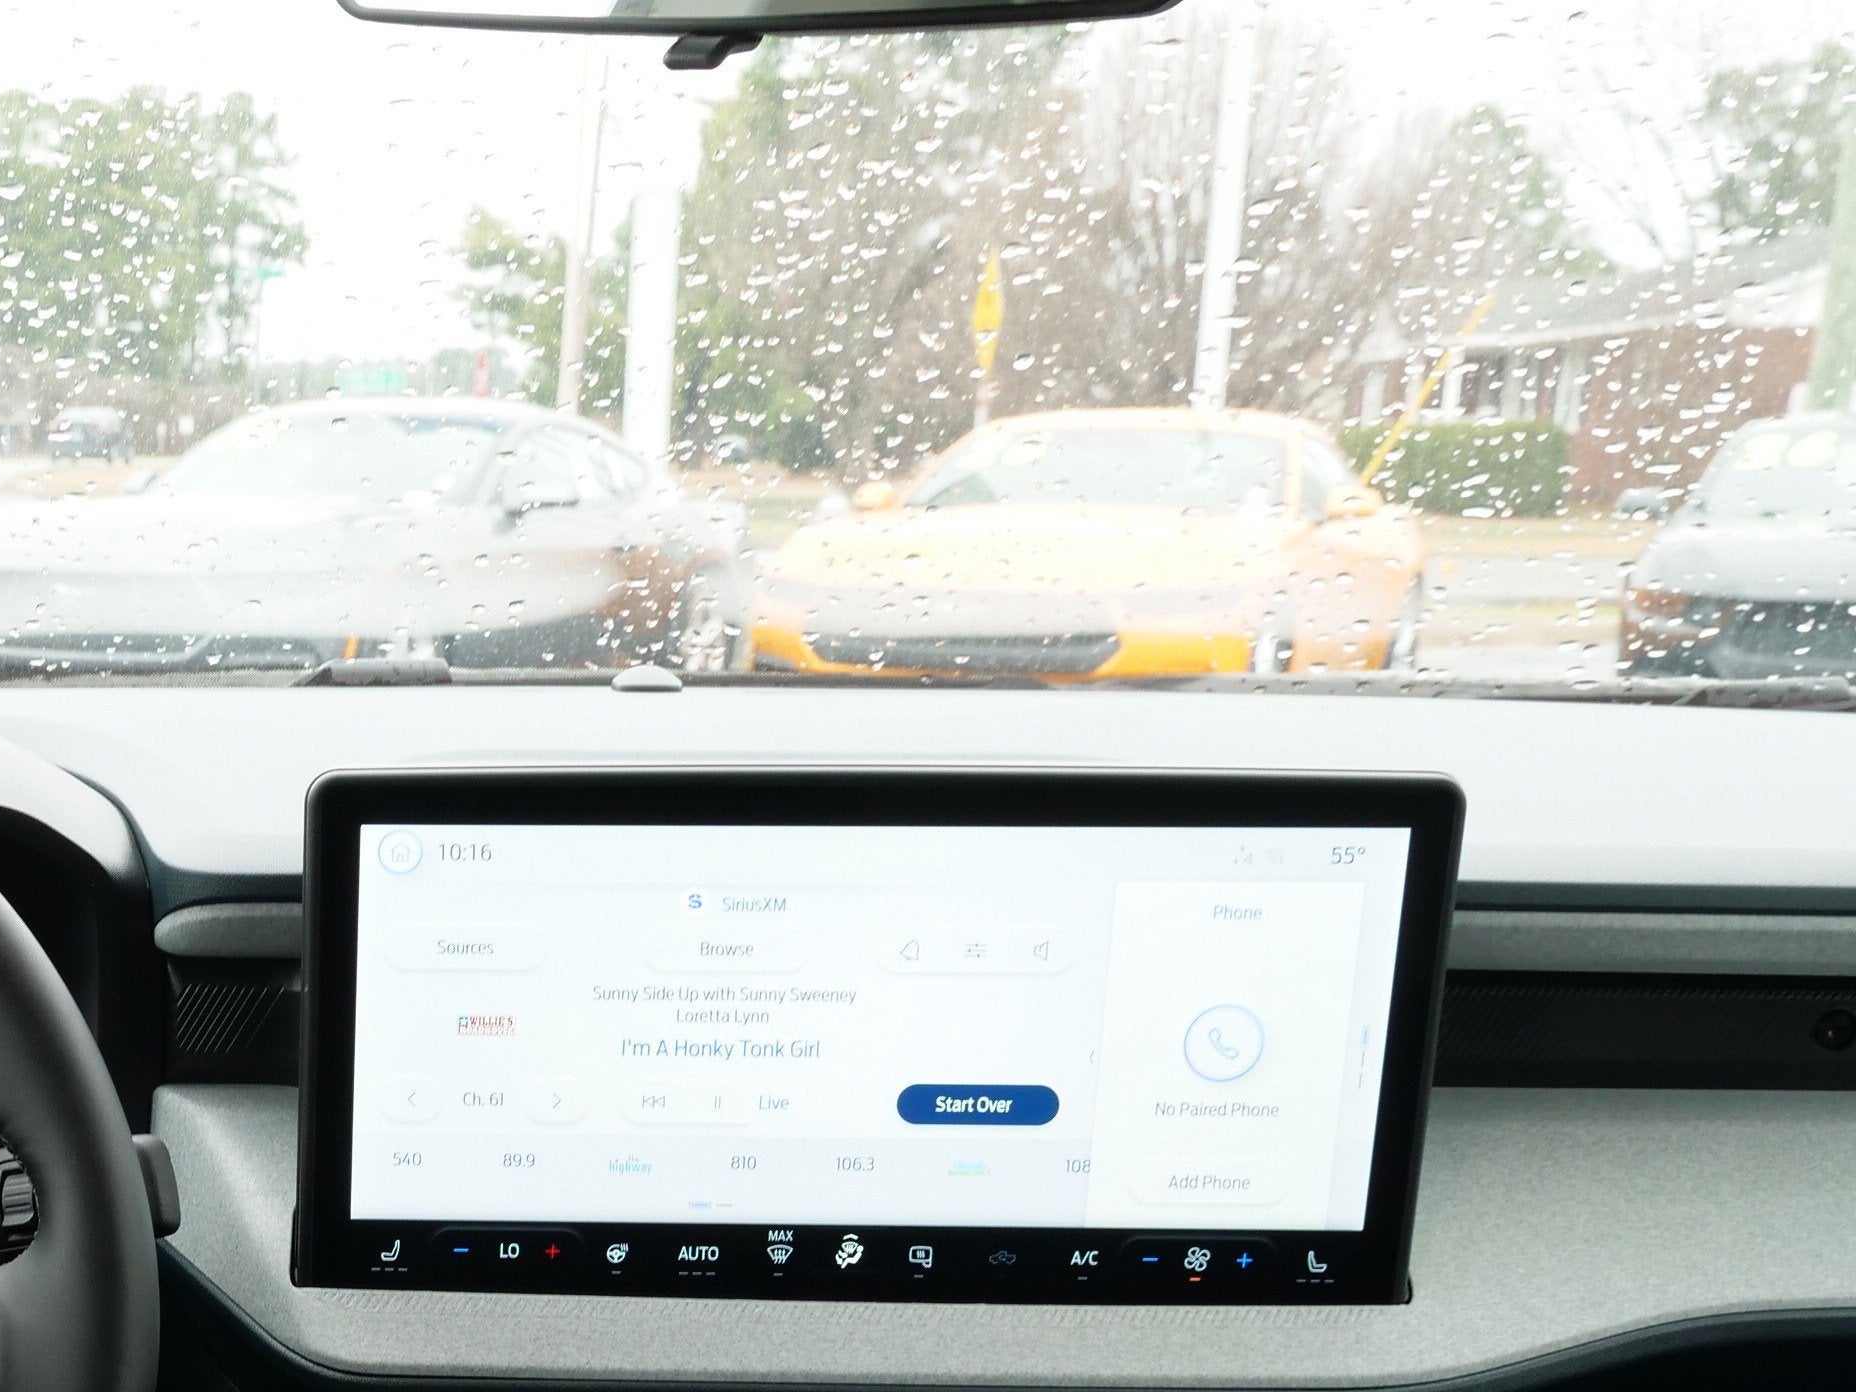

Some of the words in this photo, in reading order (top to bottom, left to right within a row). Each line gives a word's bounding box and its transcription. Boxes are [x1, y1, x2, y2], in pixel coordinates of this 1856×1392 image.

[439, 843, 492, 861] 10:16
[722, 896, 787, 912] SiriusXM
[1213, 904, 1263, 921] Phone
[437, 940, 494, 955] Sources
[700, 941, 754, 956] Browse
[593, 986, 639, 1004] Sunny
[643, 986, 674, 1001] Side
[678, 986, 698, 1003] Up
[702, 986, 736, 1001] with
[740, 987, 786, 1005] Sunny
[790, 987, 857, 1005] Sweeney
[676, 1008, 730, 1023] Loretta
[735, 1009, 770, 1026] Lynn
[621, 1039, 651, 1057] I'm
[655, 1039, 669, 1056] A
[674, 1039, 734, 1060] Honky
[740, 1039, 785, 1058] Tonk
[790, 1039, 821, 1058] Girl
[462, 1091, 486, 1106] Ch.
[489, 1091, 505, 1107] 61
[758, 1095, 789, 1111] Live
[934, 1095, 975, 1113] Start
[976, 1096, 1013, 1113] Over
[1154, 1102, 1177, 1117] No
[1179, 1101, 1228, 1117] Paired
[1230, 1102, 1280, 1117] Phone
[392, 1151, 422, 1166] 540
[502, 1153, 536, 1168] 89.9
[730, 1155, 757, 1170] 810
[836, 1157, 875, 1172] 106.3
[1168, 1174, 1198, 1189] Add
[1204, 1174, 1251, 1190] Phone
[767, 1229, 794, 1242] MAX
[499, 1242, 520, 1259] LO
[677, 1245, 720, 1262] AUTO
[1070, 1250, 1099, 1266] A/C
